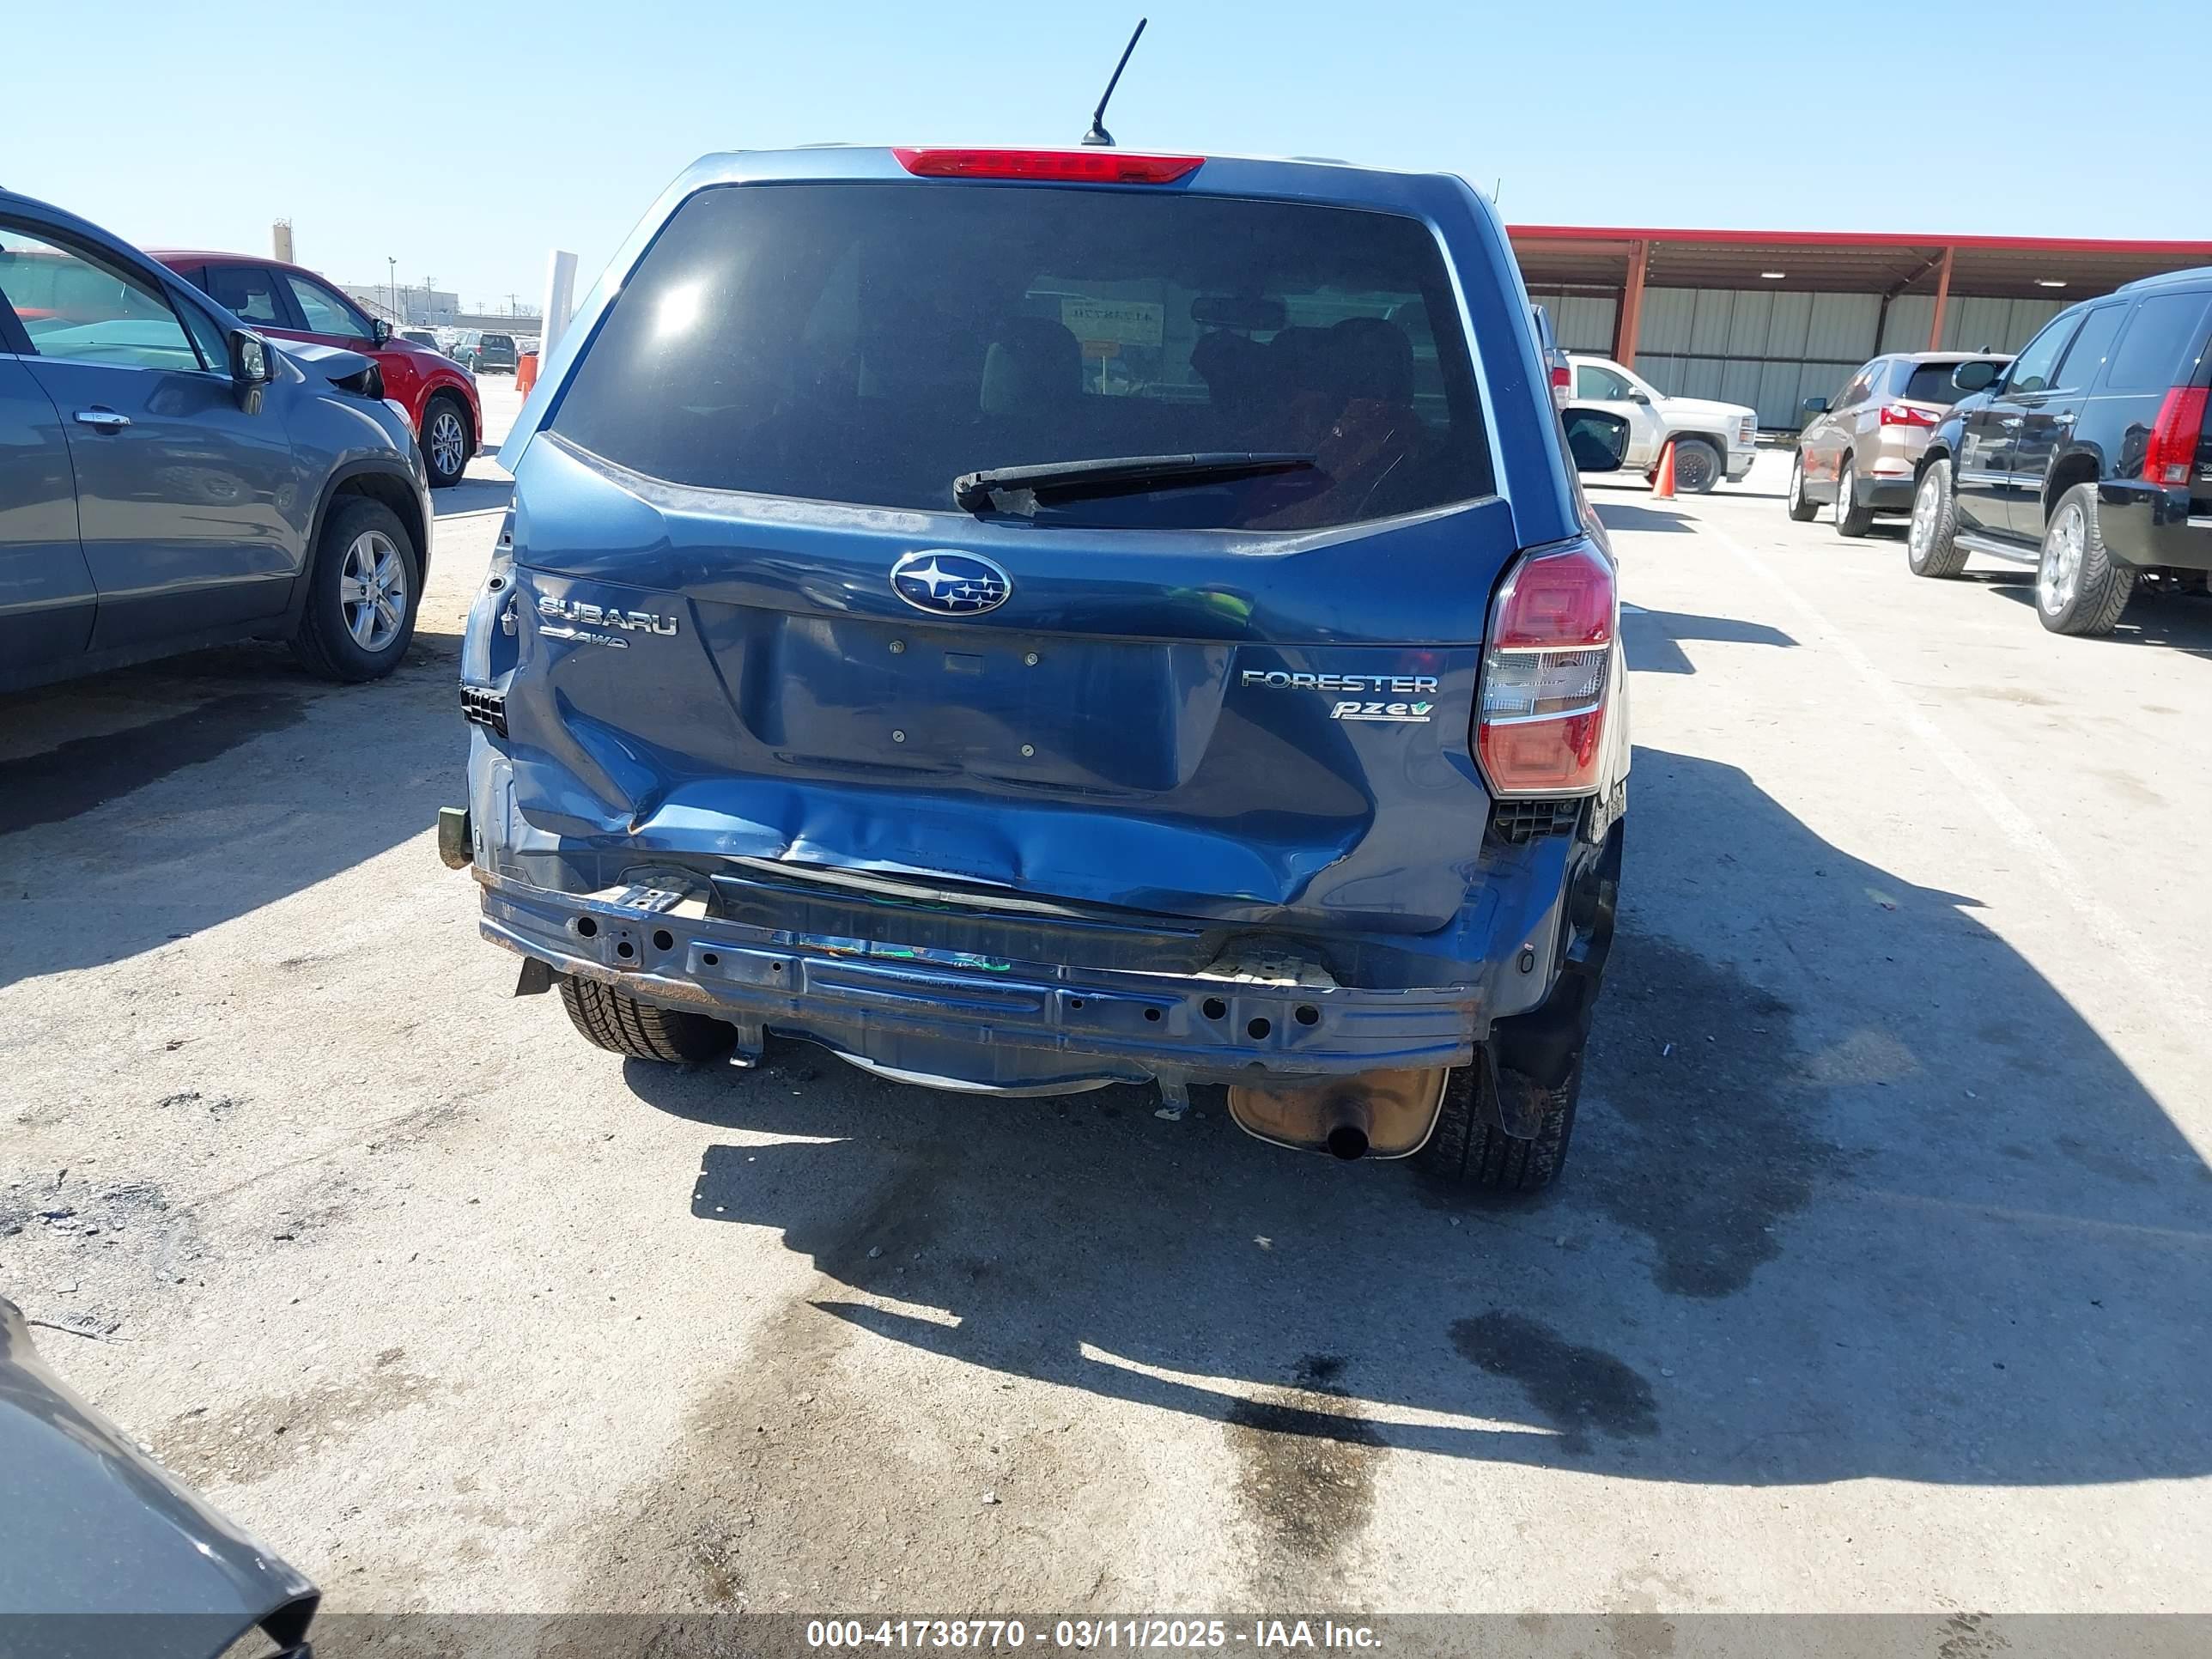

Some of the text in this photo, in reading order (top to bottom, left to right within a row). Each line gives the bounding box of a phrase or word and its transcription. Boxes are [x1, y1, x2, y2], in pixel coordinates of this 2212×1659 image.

[538, 596, 678, 635] SUBARU
[569, 631, 630, 648] AWD
[1242, 670, 1439, 694] FORESTER
